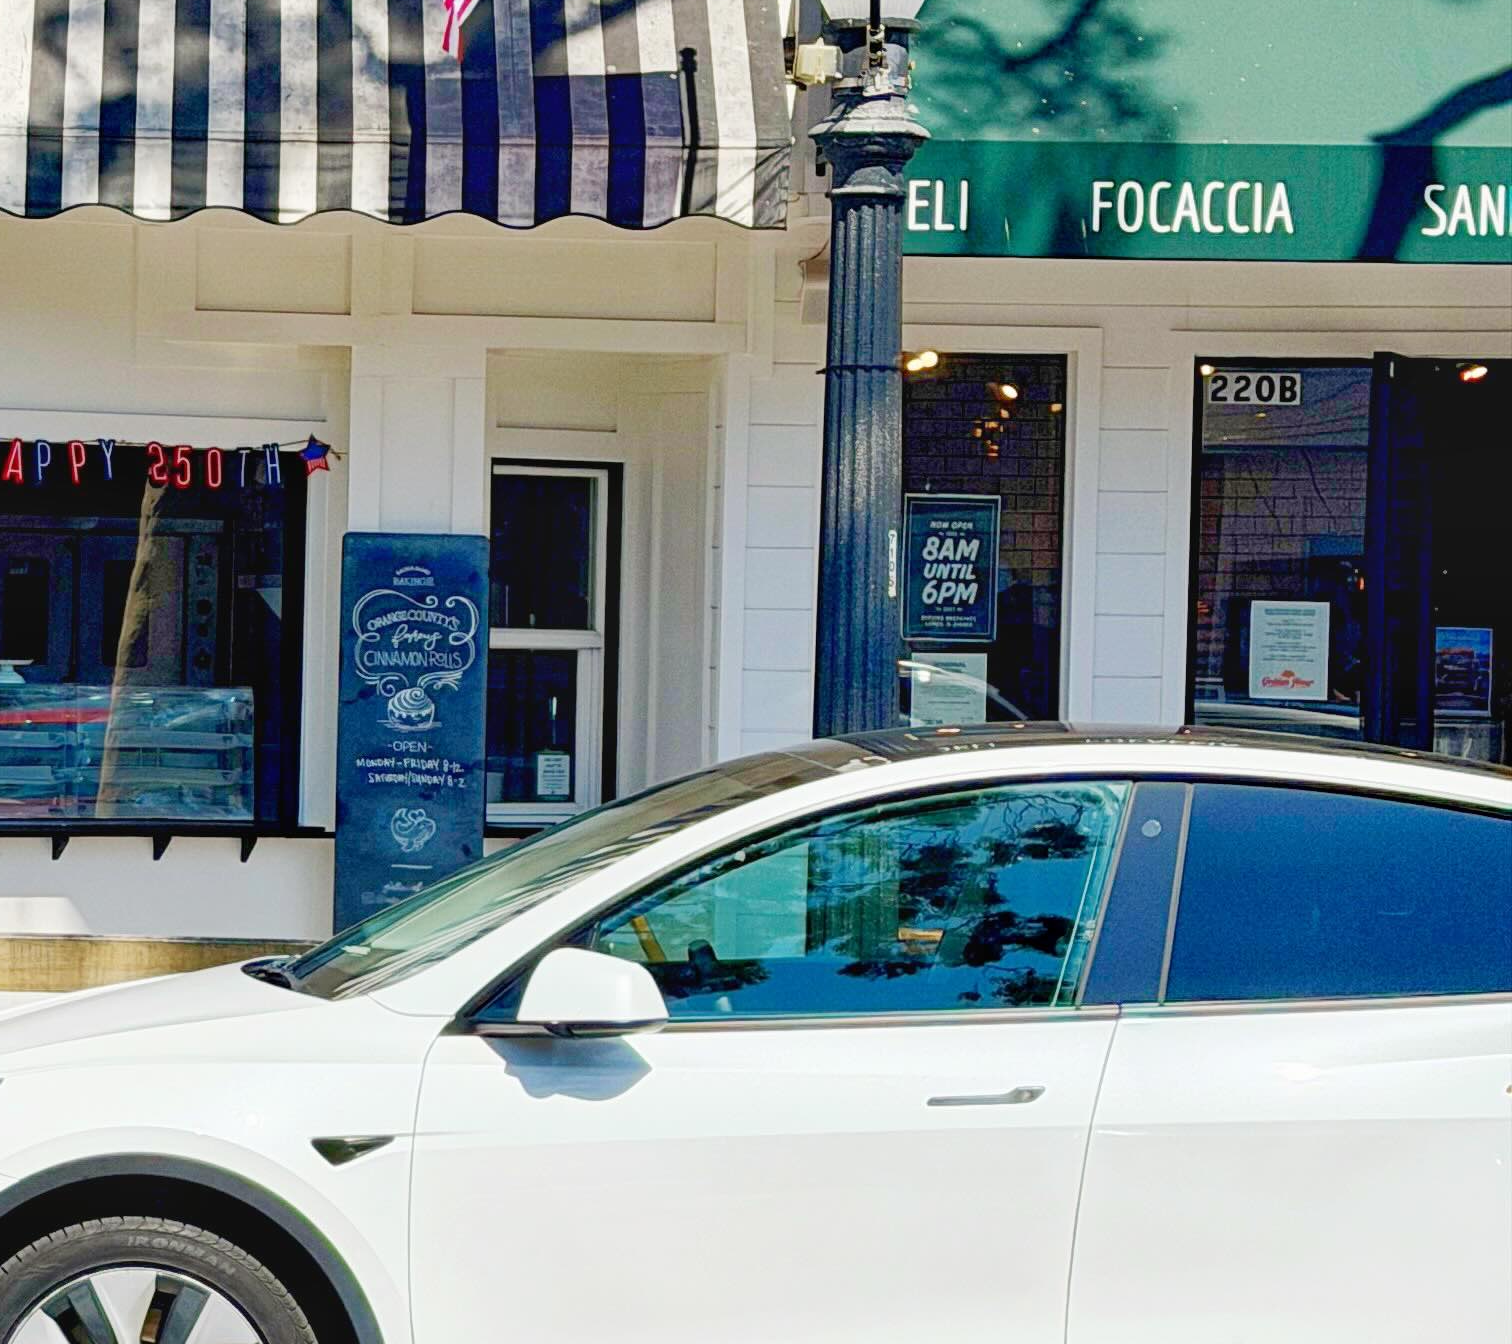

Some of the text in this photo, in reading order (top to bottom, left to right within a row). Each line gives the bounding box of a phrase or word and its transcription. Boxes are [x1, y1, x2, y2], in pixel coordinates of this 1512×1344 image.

[907, 179, 1512, 237] ELI FOCACCIA SAN
[1210, 374, 1298, 403] 220B
[145, 441, 284, 489] 250TH
[922, 536, 980, 562] 8AM
[923, 563, 977, 580] UNTIL
[921, 579, 978, 605] 6PM
[367, 610, 407, 631] ORANGE
[363, 650, 463, 669] CINNAMON ROLLS
[127, 1235, 236, 1275] IRONMAN
